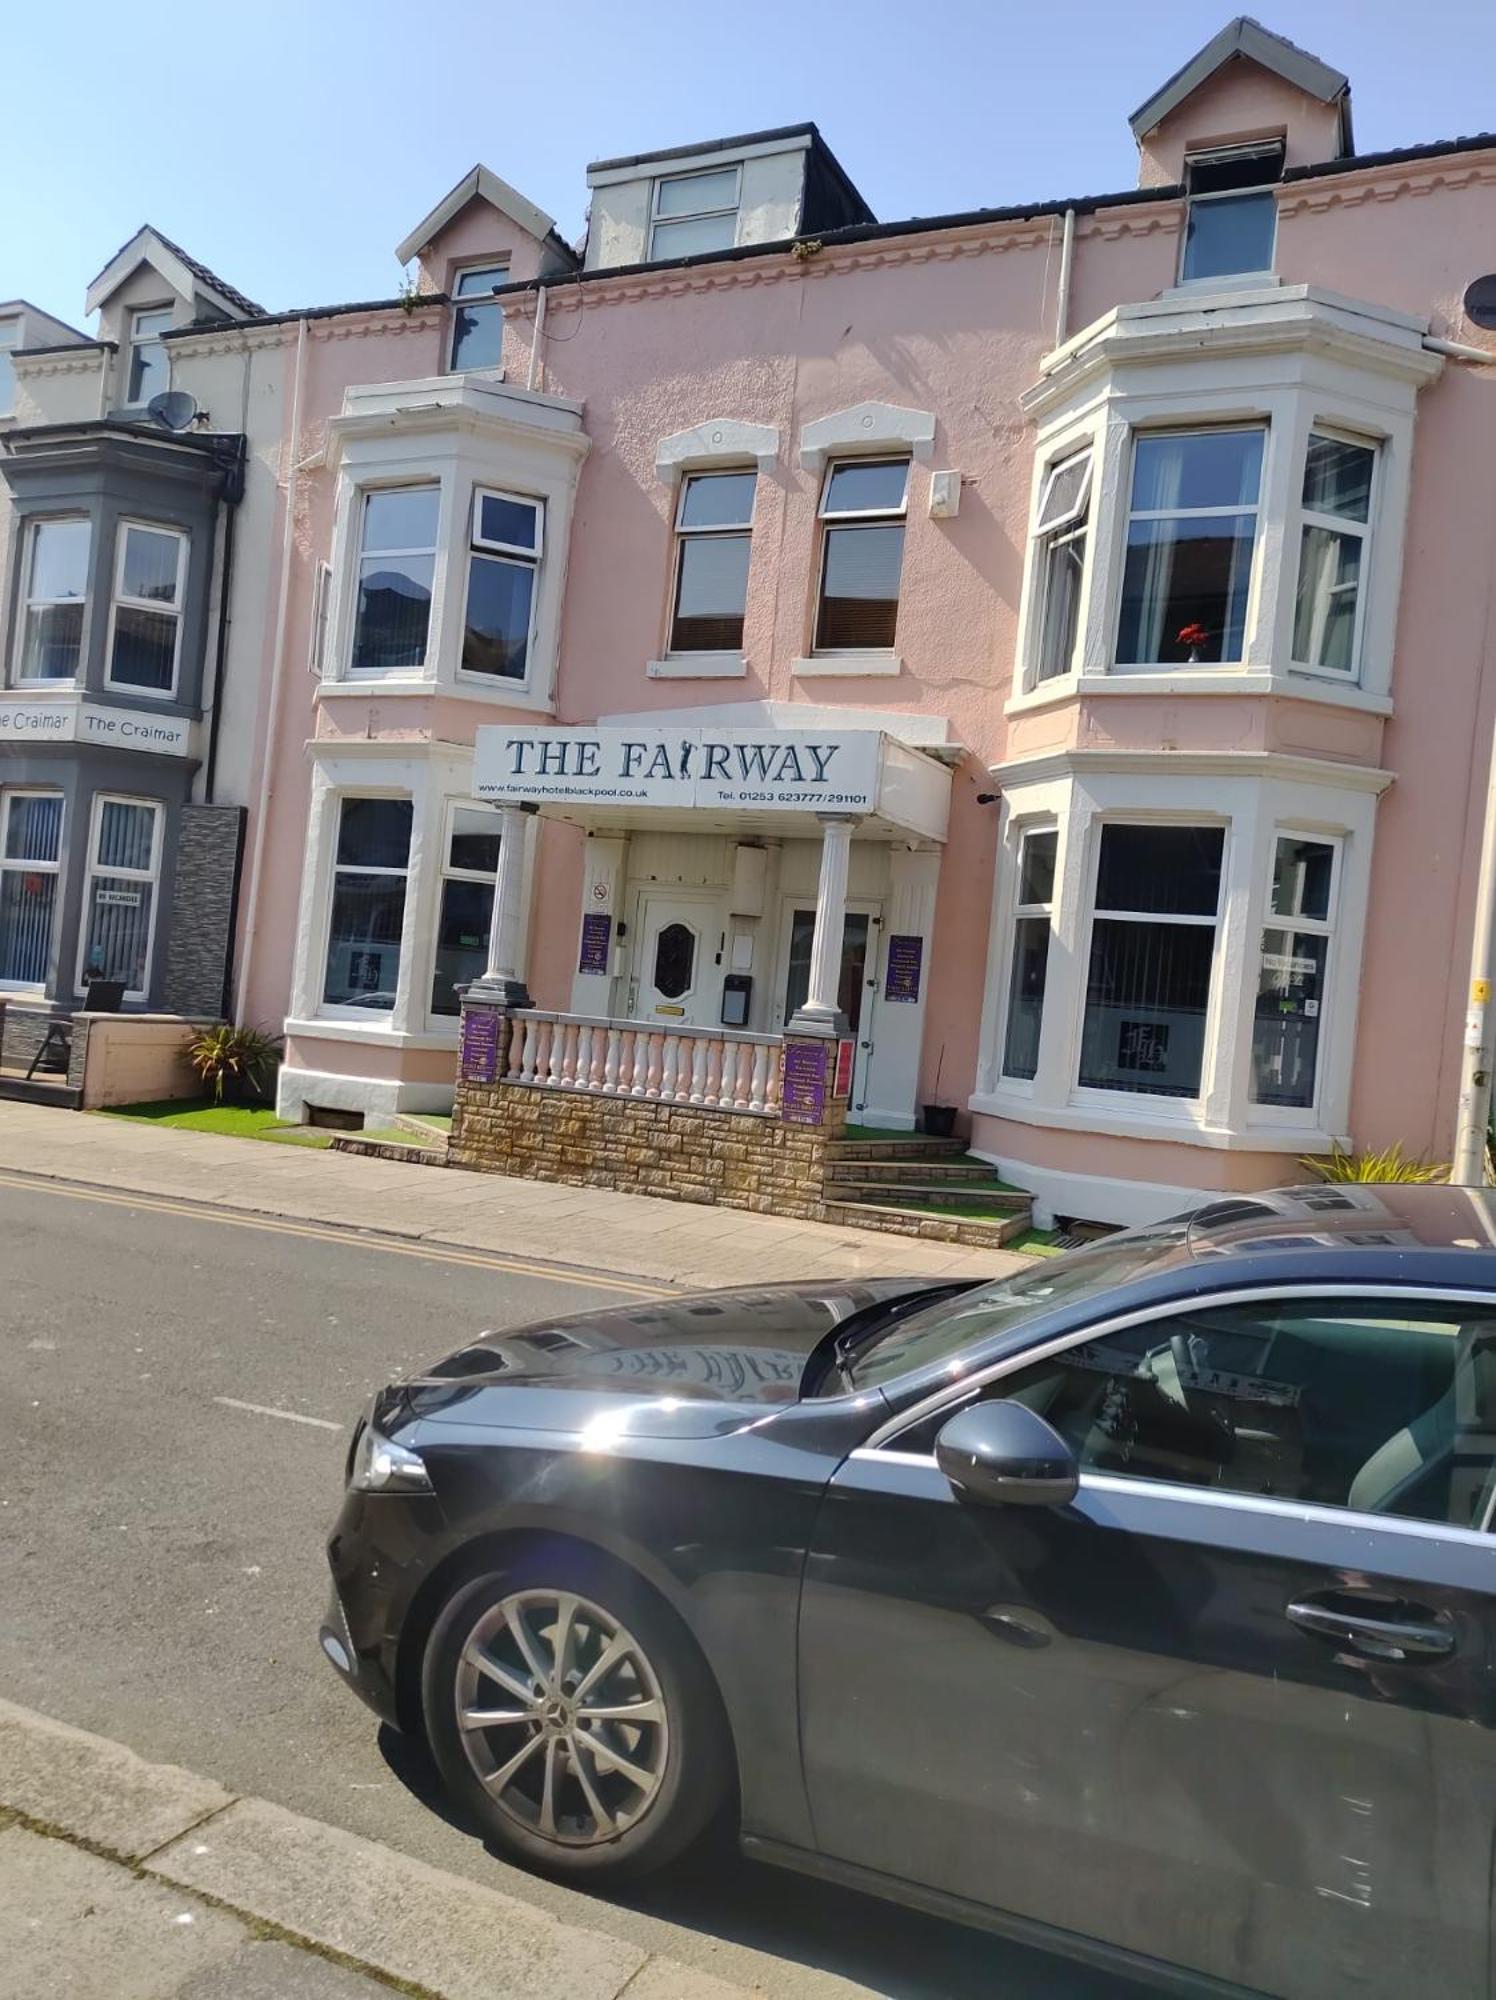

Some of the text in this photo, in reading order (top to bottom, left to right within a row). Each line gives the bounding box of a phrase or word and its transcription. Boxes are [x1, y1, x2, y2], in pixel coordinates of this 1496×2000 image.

[14, 712, 69, 729] Craimar
[85, 716, 182, 742] The Craimar
[505, 740, 840, 782] THE FAIRWAY
[479, 783, 648, 798] www.fairwayhotelblackpool.co.uk
[717, 791, 867, 804] Tel. 01253 623777/291101
